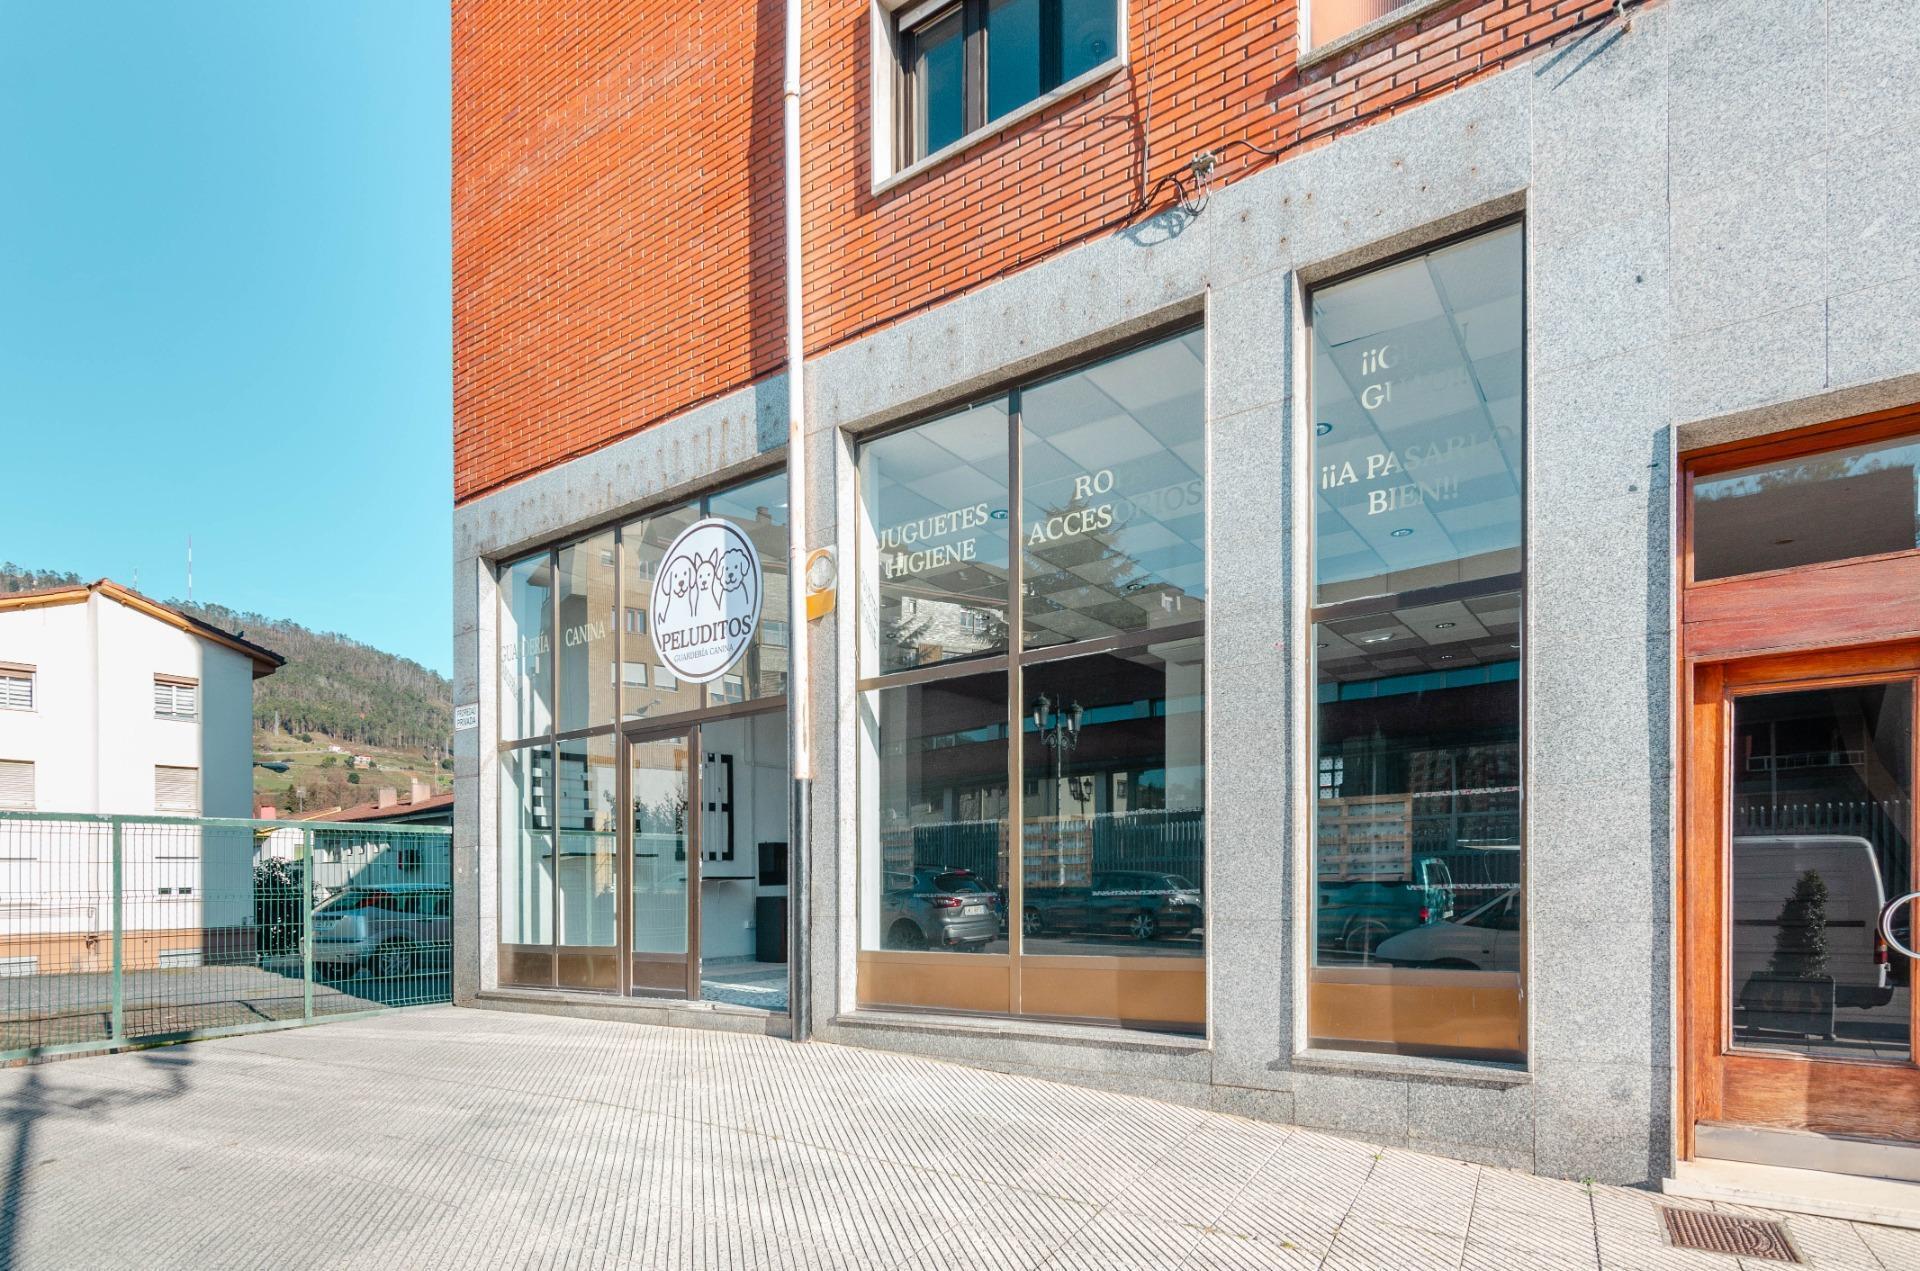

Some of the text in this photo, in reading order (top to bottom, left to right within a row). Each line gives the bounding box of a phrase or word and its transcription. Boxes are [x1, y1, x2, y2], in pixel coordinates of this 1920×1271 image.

[1367, 475, 1459, 515] BIEN!!
[879, 503, 989, 551] JUGUETES
[886, 538, 977, 579] HIGIENE
[500, 630, 550, 662] GUADERÍA
[565, 621, 606, 647] CANINA
[662, 614, 752, 652] PELUDITOS
[673, 643, 734, 662] GUARDERÍA CANINA
